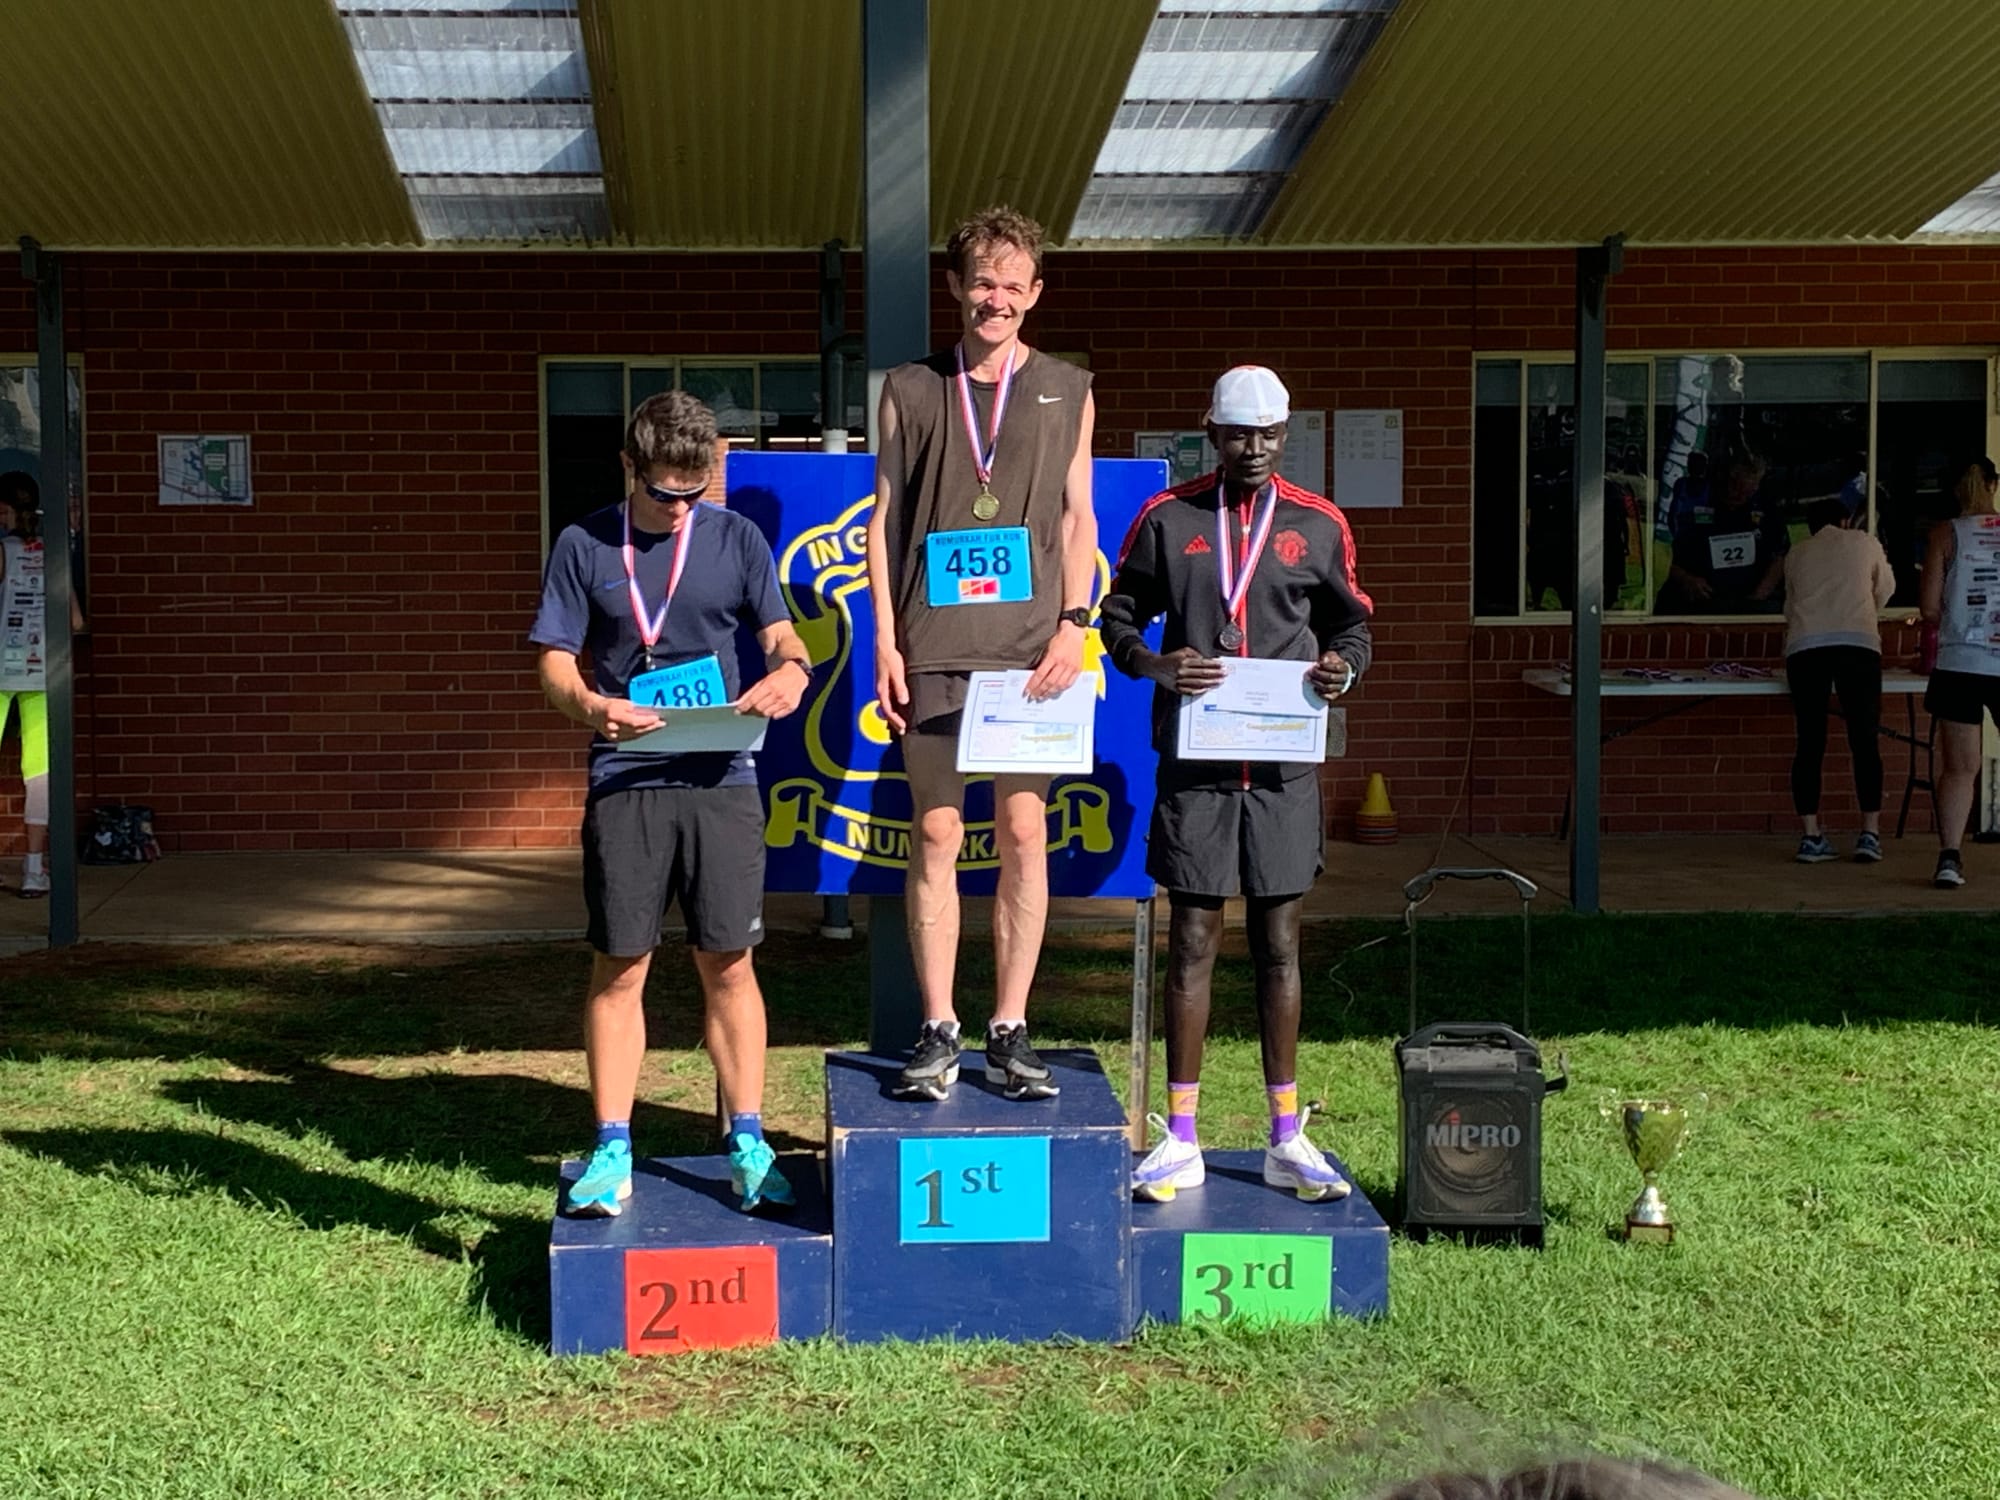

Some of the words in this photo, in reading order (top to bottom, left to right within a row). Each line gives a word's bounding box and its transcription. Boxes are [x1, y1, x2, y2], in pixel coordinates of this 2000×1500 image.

[807, 535, 844, 569] IN
[945, 546, 1011, 577] 458
[1722, 547, 1745, 561] 22
[653, 678, 712, 707] 488
[915, 1161, 1004, 1228] 1st
[639, 1266, 747, 1340] 2nd
[1195, 1252, 1295, 1321] 3rd
